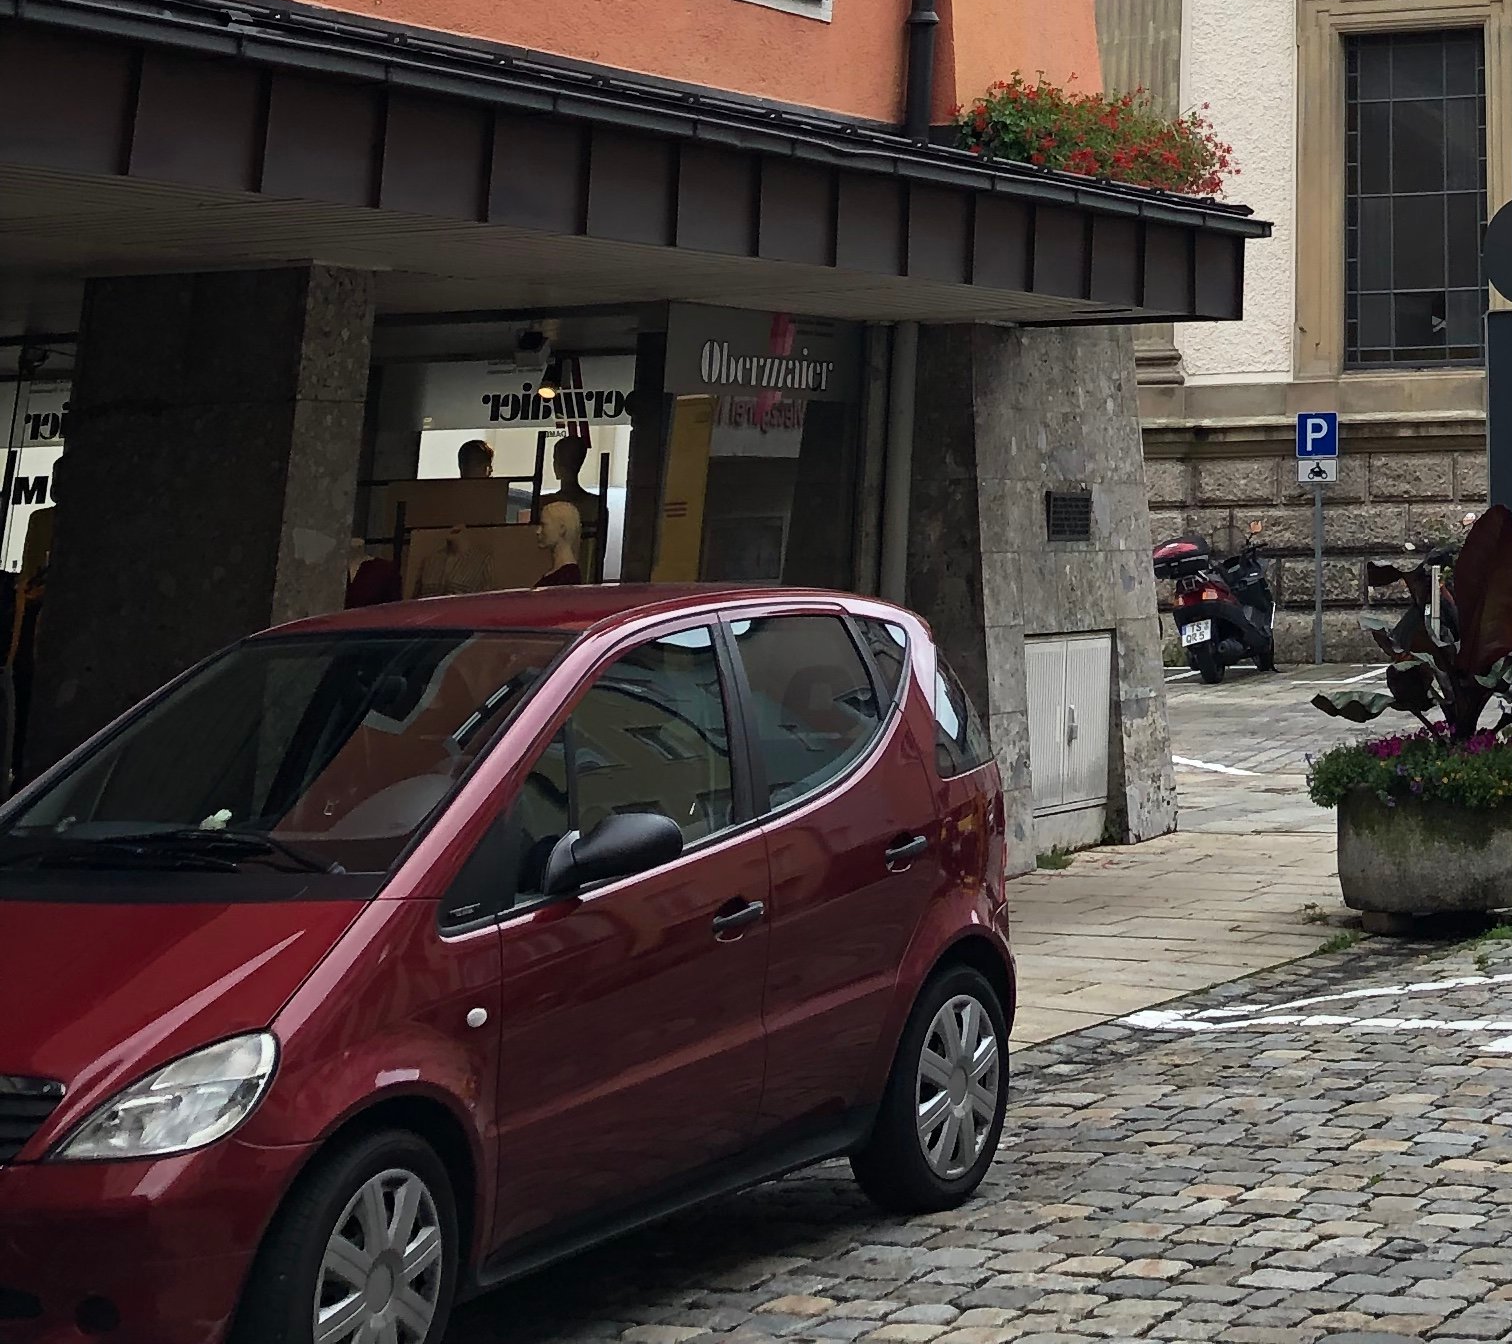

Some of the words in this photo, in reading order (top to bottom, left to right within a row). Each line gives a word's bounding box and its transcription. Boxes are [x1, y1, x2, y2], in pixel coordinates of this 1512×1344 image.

[701, 339, 834, 392] Obermaier
[1306, 418, 1328, 452] P
[1190, 623, 1201, 633] TS
